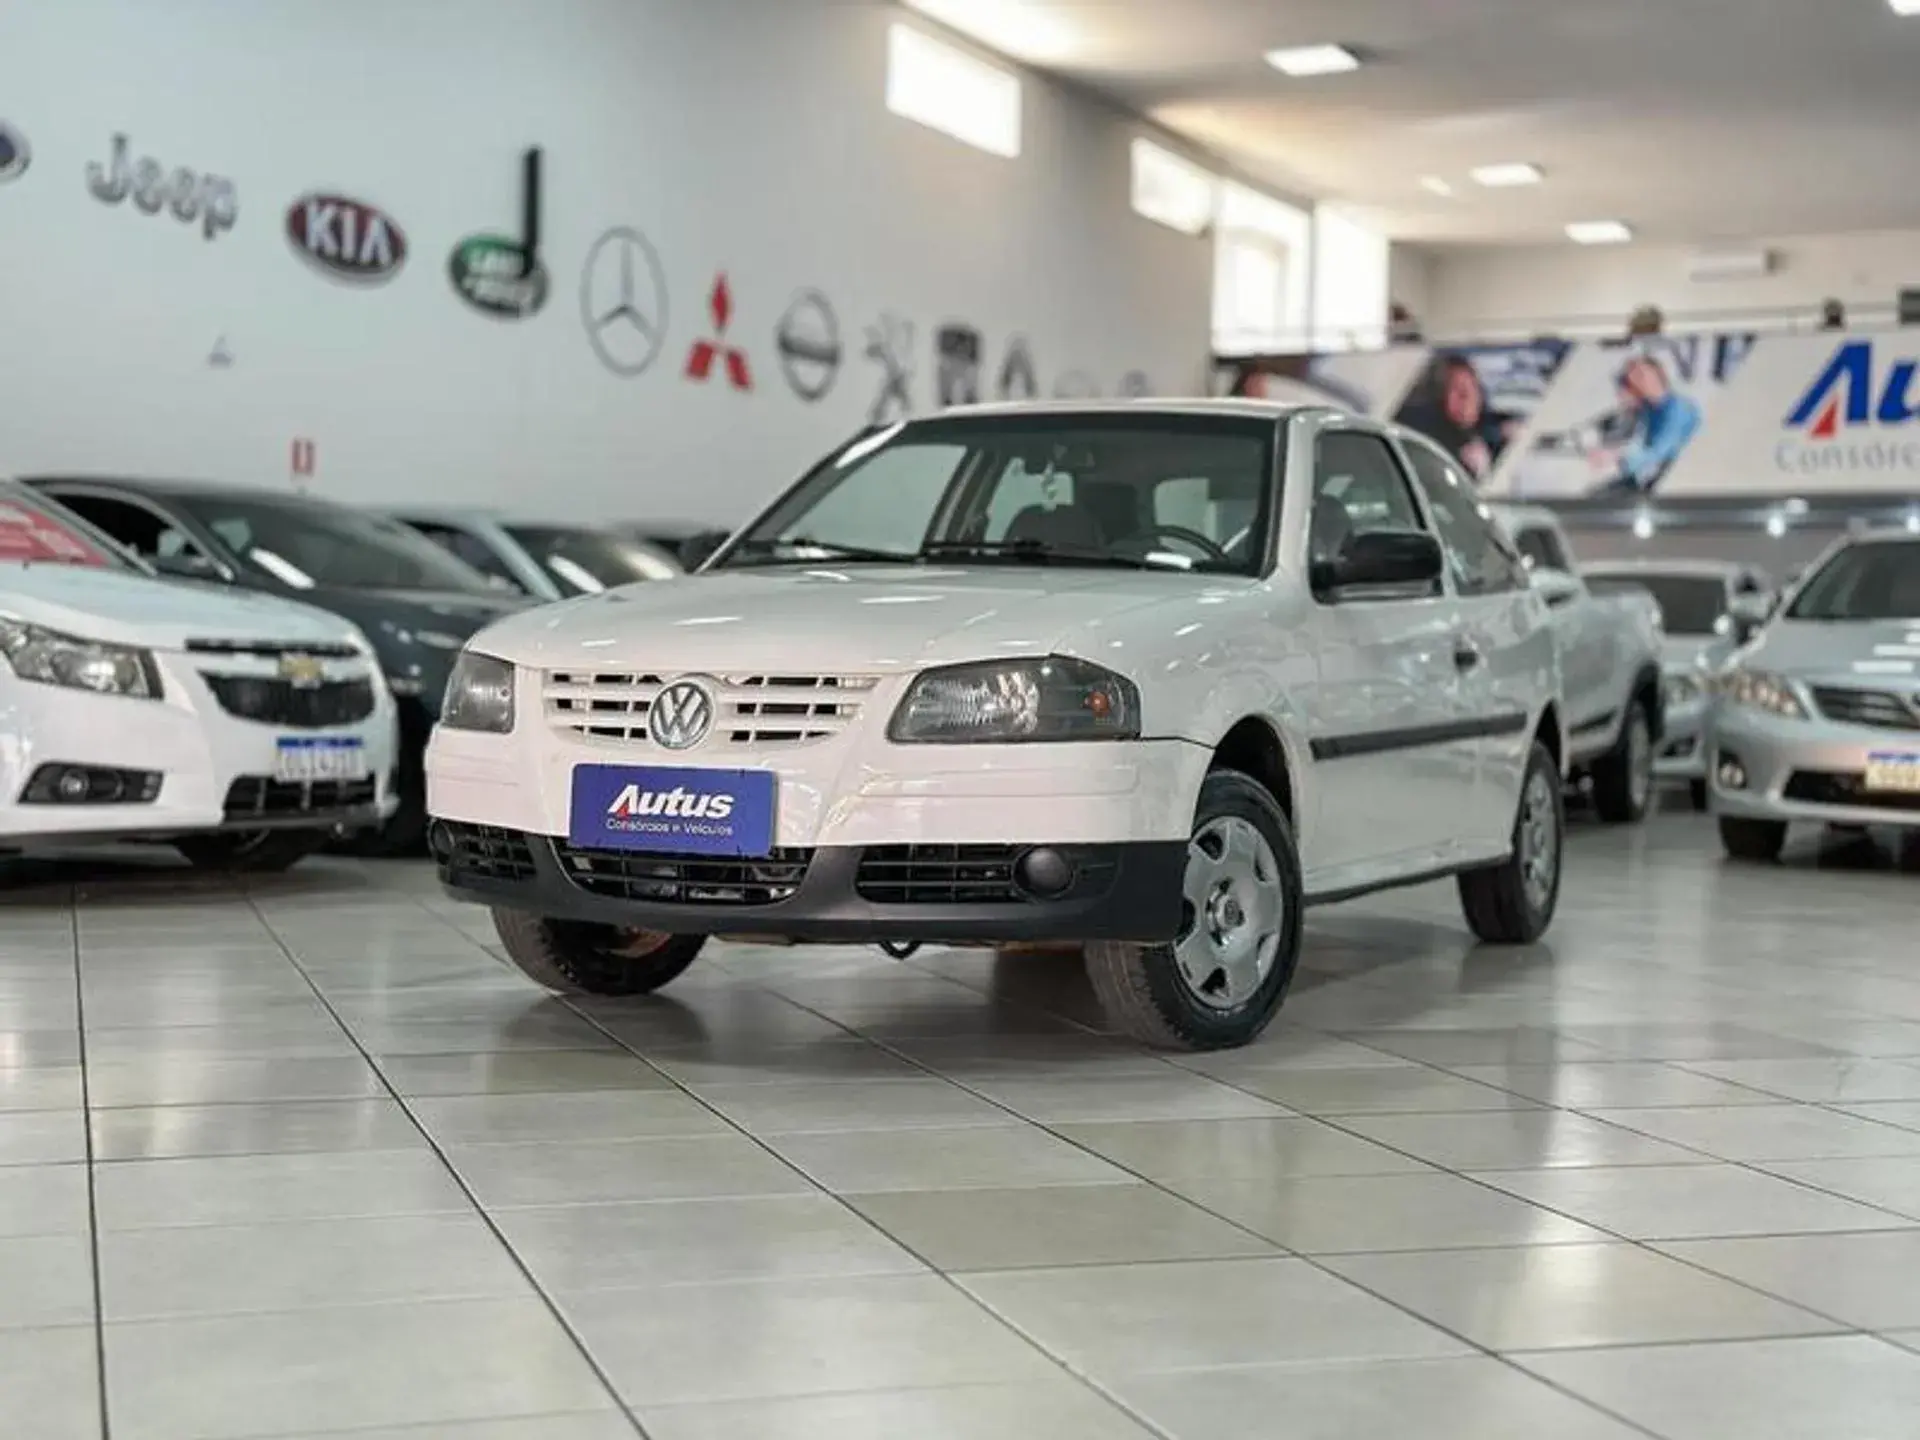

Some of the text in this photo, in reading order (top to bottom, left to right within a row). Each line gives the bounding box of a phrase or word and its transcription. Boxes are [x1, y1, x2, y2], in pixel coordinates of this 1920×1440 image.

[86, 133, 238, 240] Jeep
[304, 197, 392, 266] KIA
[606, 819, 669, 833] Consórcios
[684, 821, 733, 835] Veículos
[607, 784, 734, 819] Autus
